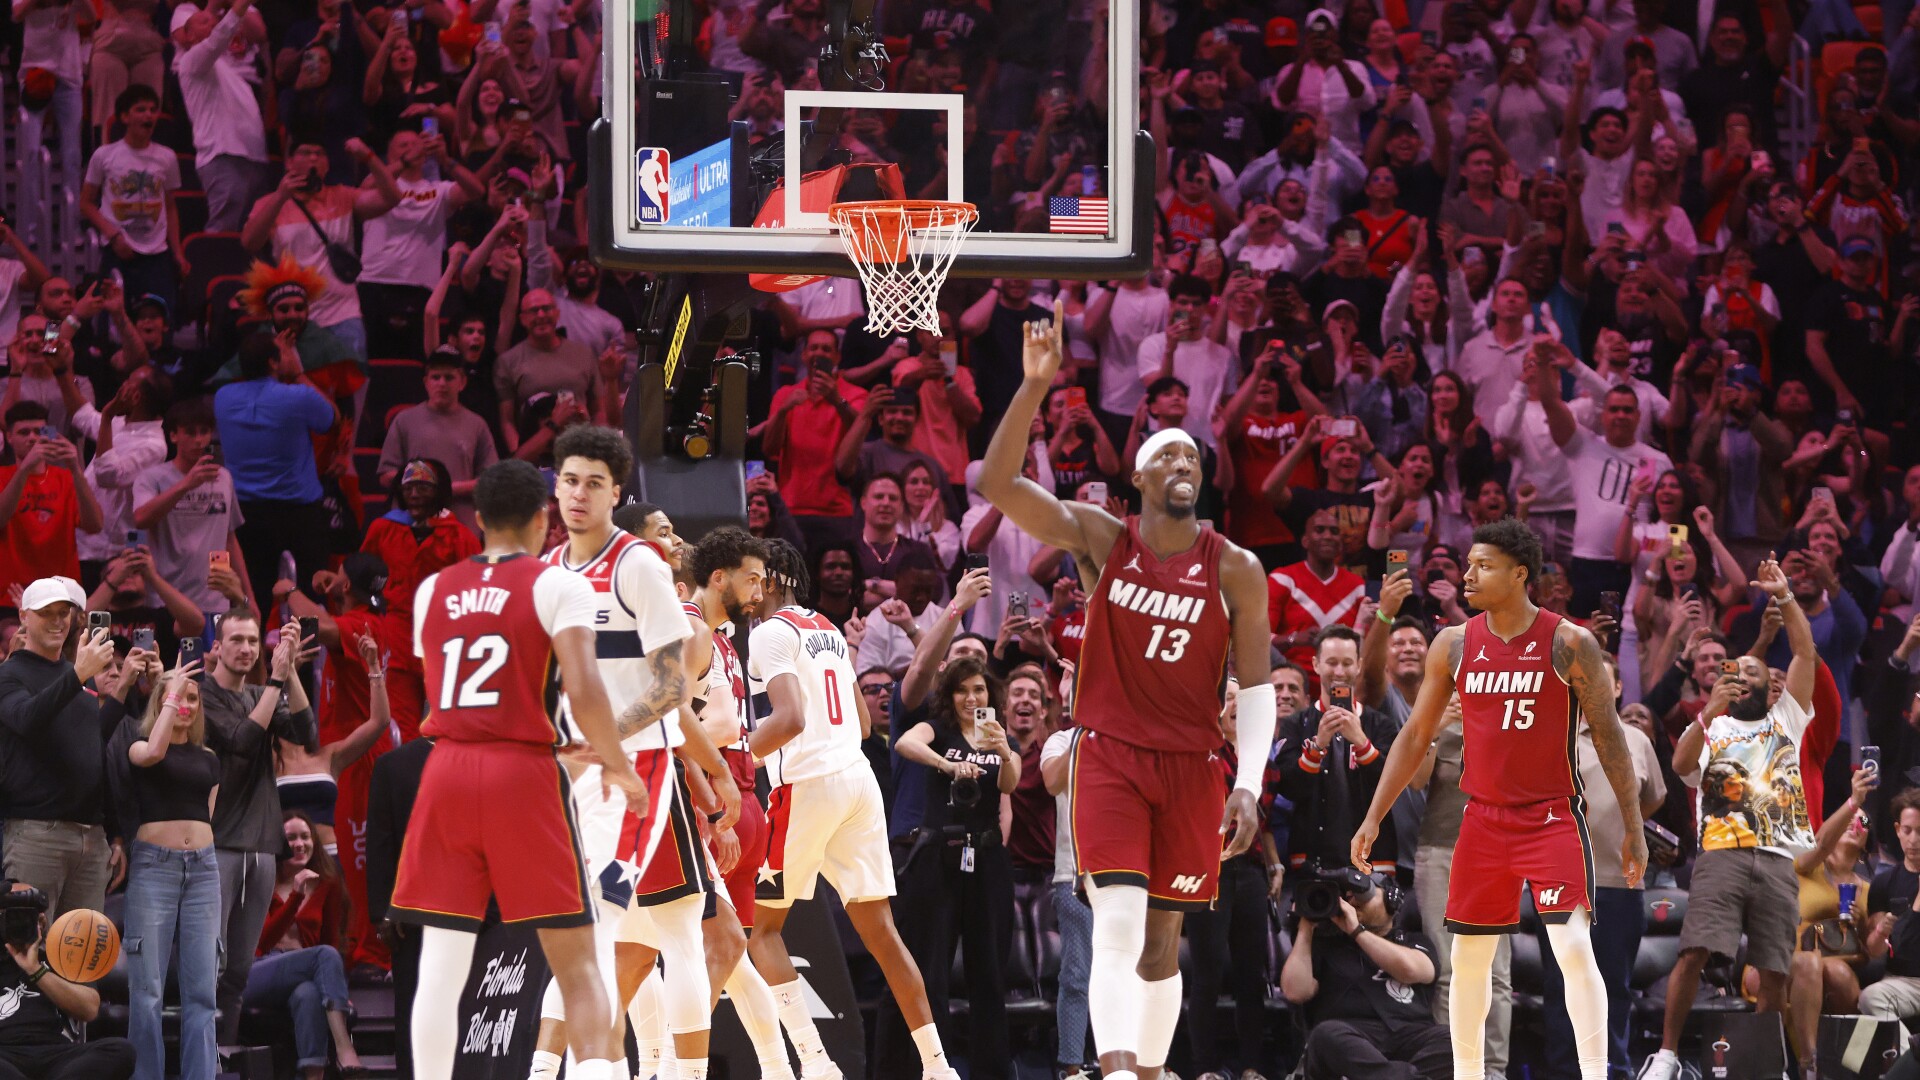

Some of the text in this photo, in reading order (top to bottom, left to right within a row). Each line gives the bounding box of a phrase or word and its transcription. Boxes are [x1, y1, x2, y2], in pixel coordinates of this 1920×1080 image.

[921, 9, 975, 38] HEAT
[699, 158, 729, 195] ULTRA
[641, 206, 658, 220] NBA
[1178, 577, 1207, 587] Robinhood
[445, 586, 511, 620] SMITH
[1107, 578, 1206, 624] MIAMI
[805, 632, 846, 660] COULIBALY
[1144, 624, 1191, 663] 13
[439, 634, 510, 711] 12
[1464, 671, 1545, 694] MIAMI
[824, 669, 844, 725] 0
[1501, 698, 1536, 730] 15
[944, 748, 1002, 766] EL HEAT
[86, 923, 109, 971] Wilson
[476, 947, 527, 1000] Florida
[462, 1005, 494, 1055] Blue
